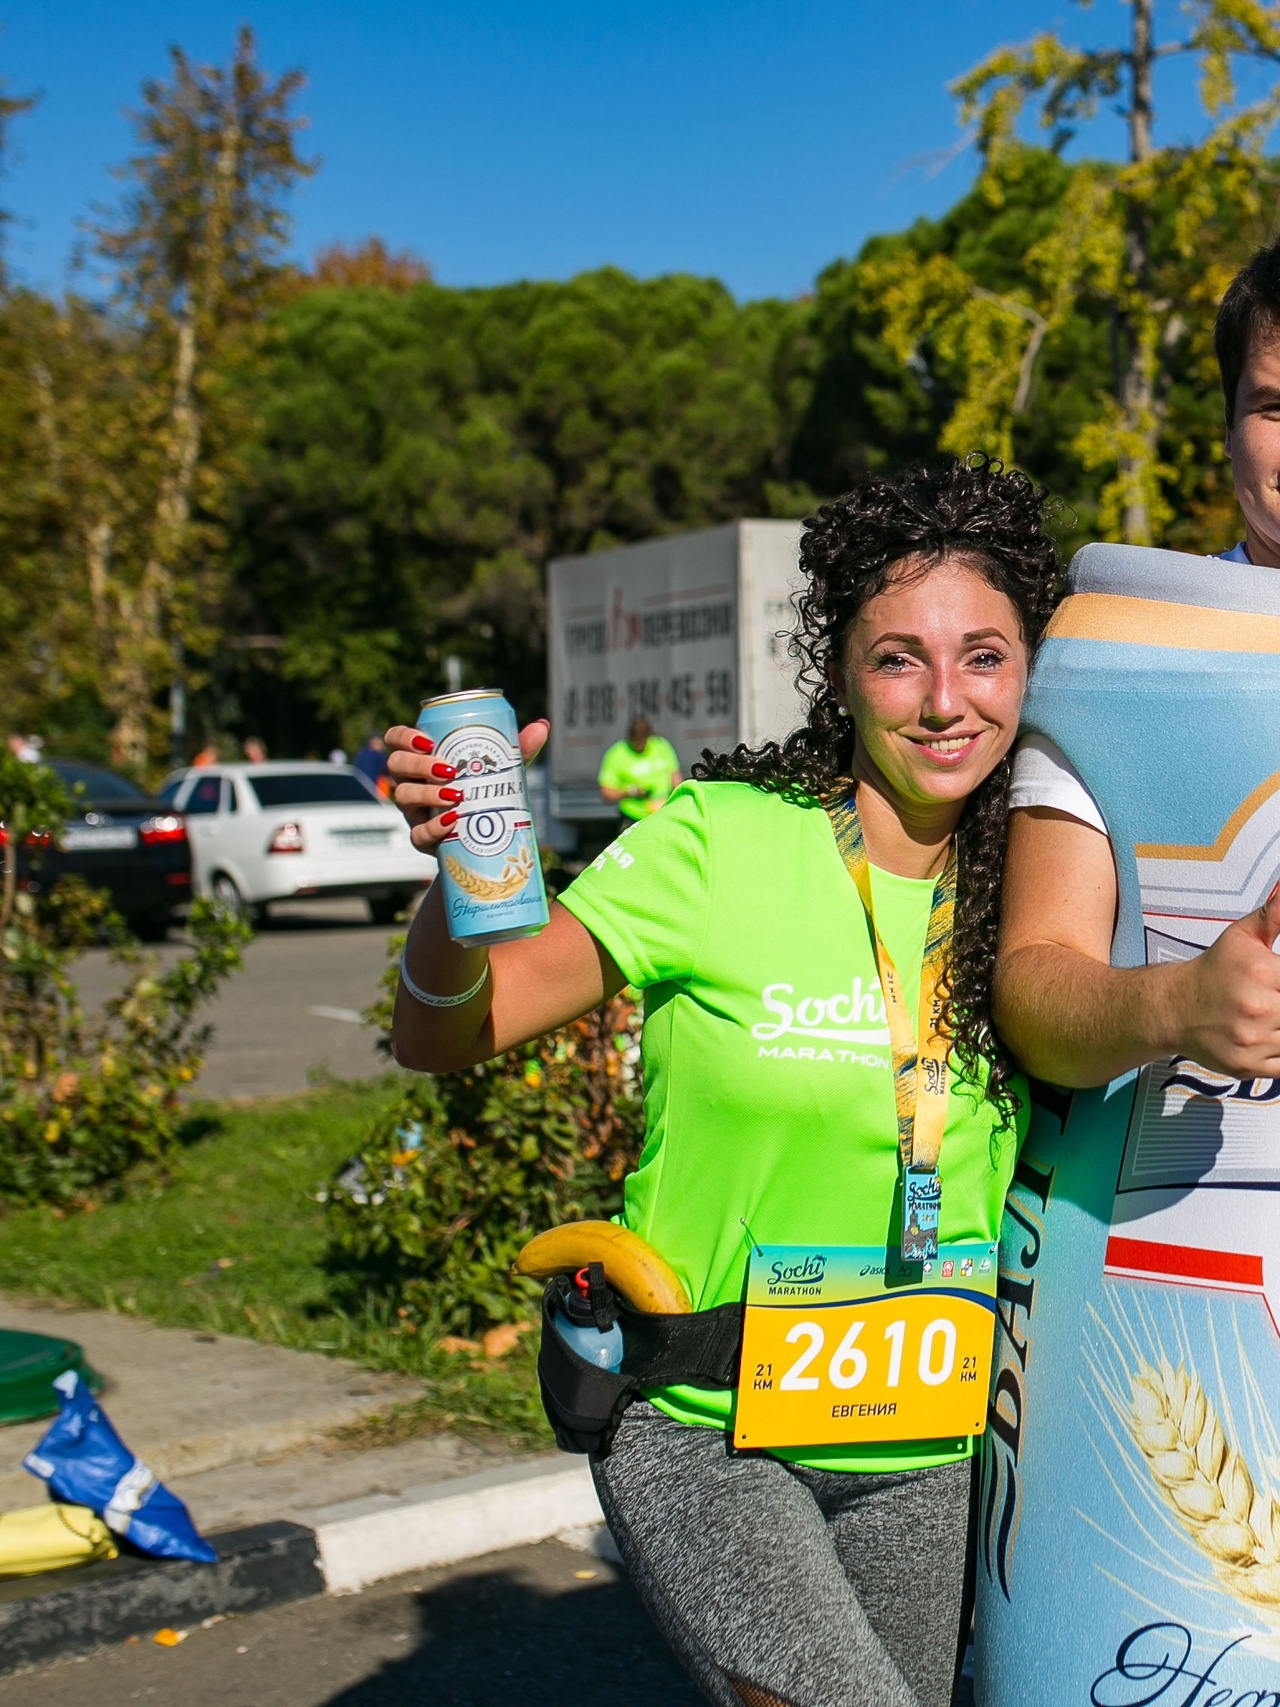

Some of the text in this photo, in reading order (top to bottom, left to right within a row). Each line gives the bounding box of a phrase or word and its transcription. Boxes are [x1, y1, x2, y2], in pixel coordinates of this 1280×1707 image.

[462, 781, 524, 802] ЛТИКА
[757, 1045, 890, 1070] MARATHON
[920, 1057, 940, 1096] Sochi
[907, 1177, 942, 1202] Sochi
[766, 1254, 827, 1285] Sochi
[768, 1286, 822, 1296] MARATHON
[779, 1318, 957, 1391] 2610
[962, 1356, 977, 1369] 21
[755, 1363, 772, 1377] 21
[831, 1402, 897, 1419] ЕВГЕНИЯ
